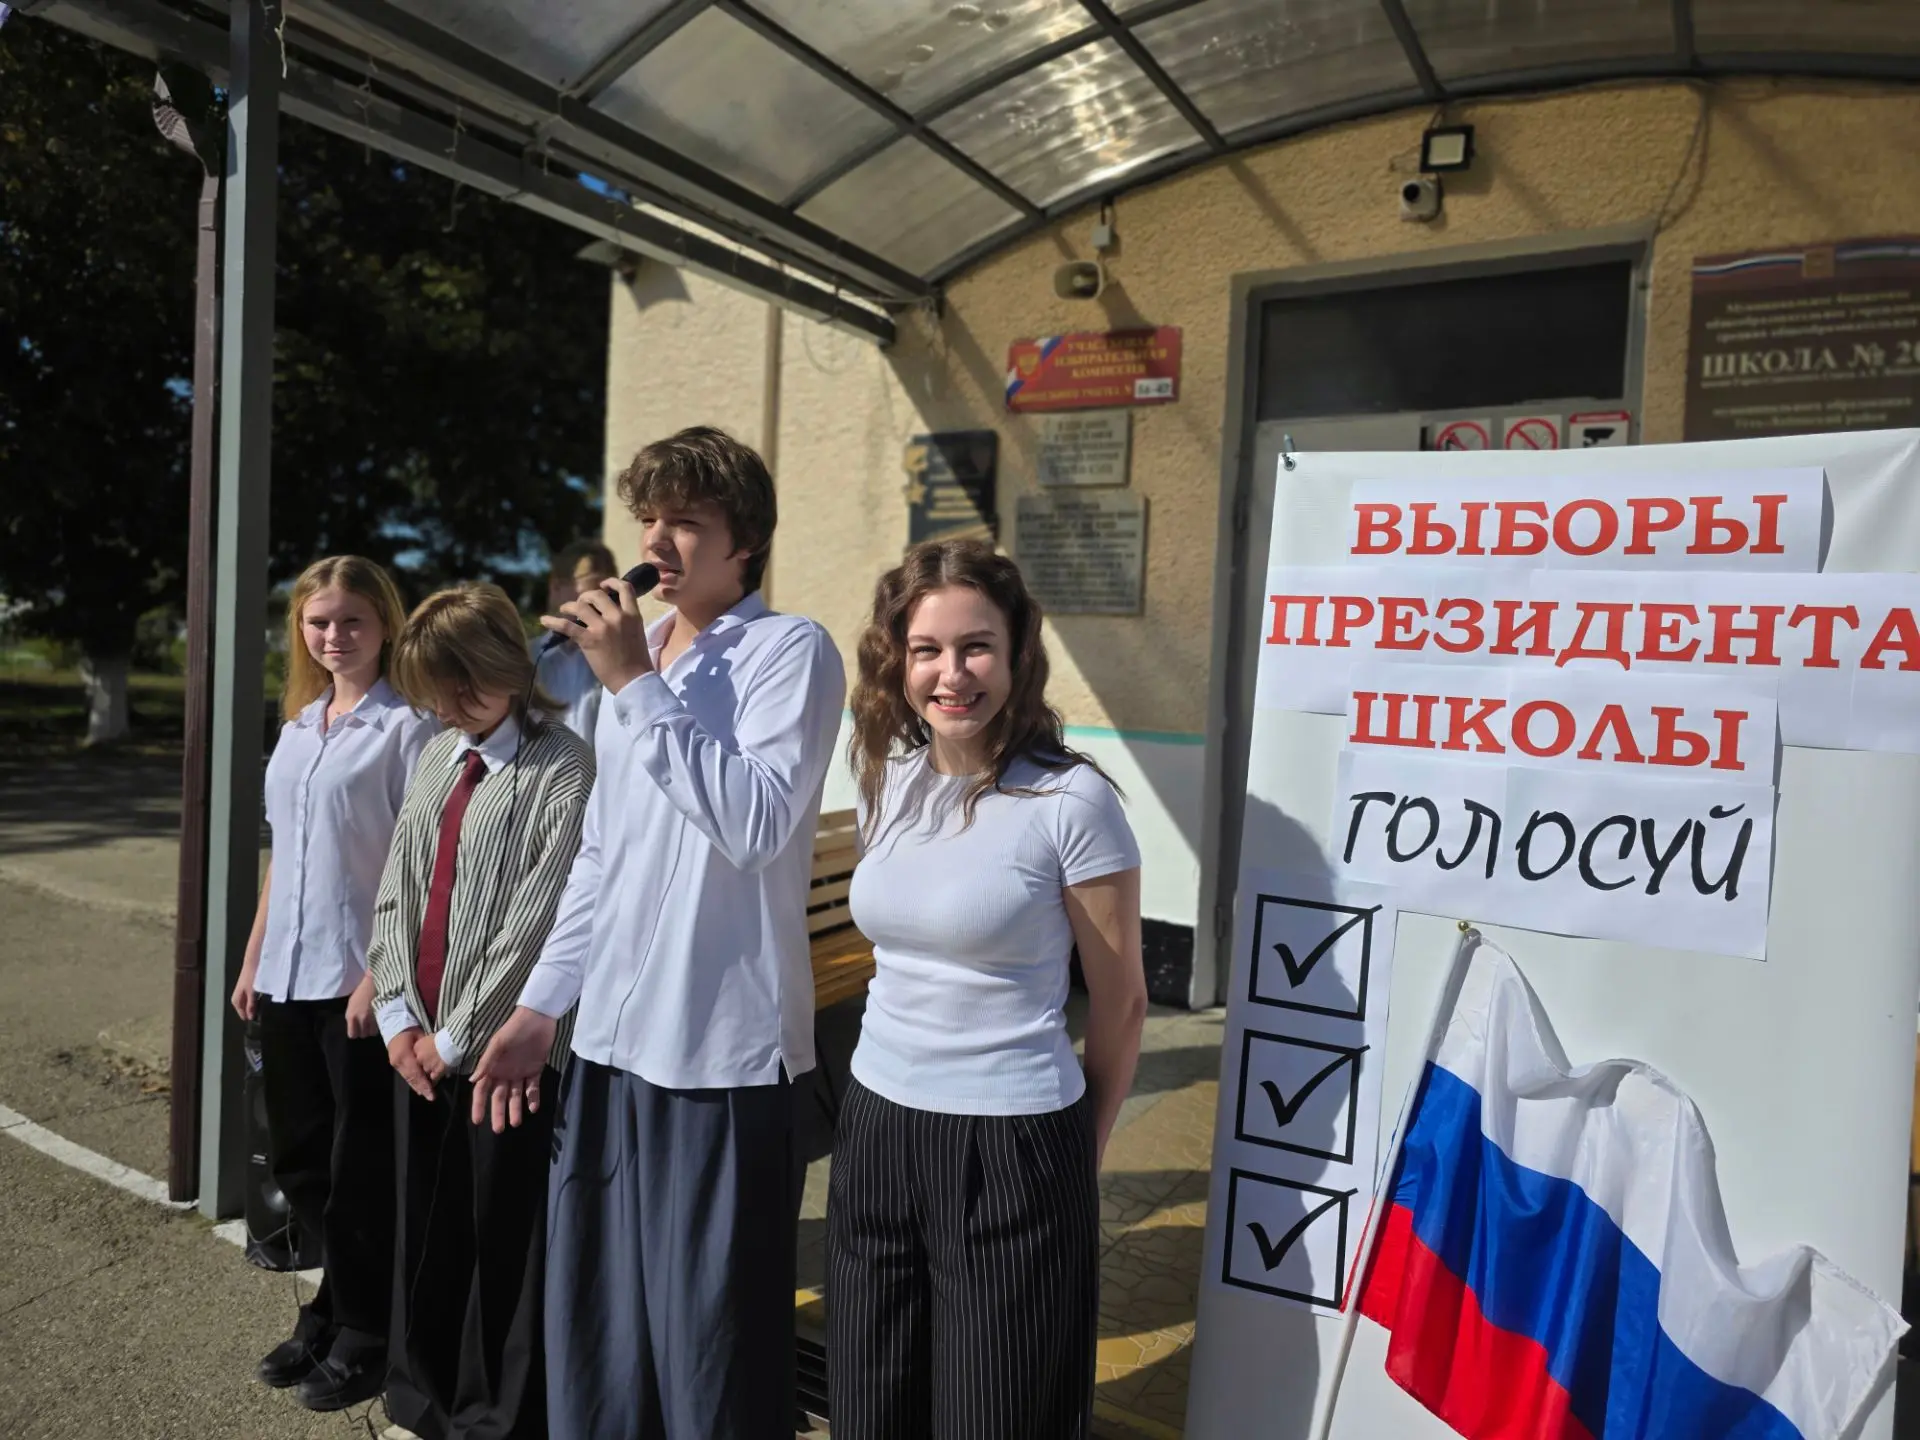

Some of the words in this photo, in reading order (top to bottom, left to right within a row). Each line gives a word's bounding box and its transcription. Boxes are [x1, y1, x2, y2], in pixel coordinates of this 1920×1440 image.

[1702, 348, 1838, 378] ШКОЛА
[1848, 342, 1886, 367] №
[1350, 495, 1788, 556] ВЫБОРЫ
[1266, 595, 1920, 671] ПРЕЗИДЕНТА
[1348, 691, 1749, 771] ШКОЛЫ
[1343, 791, 1754, 901] ГОЛОСУЙ
